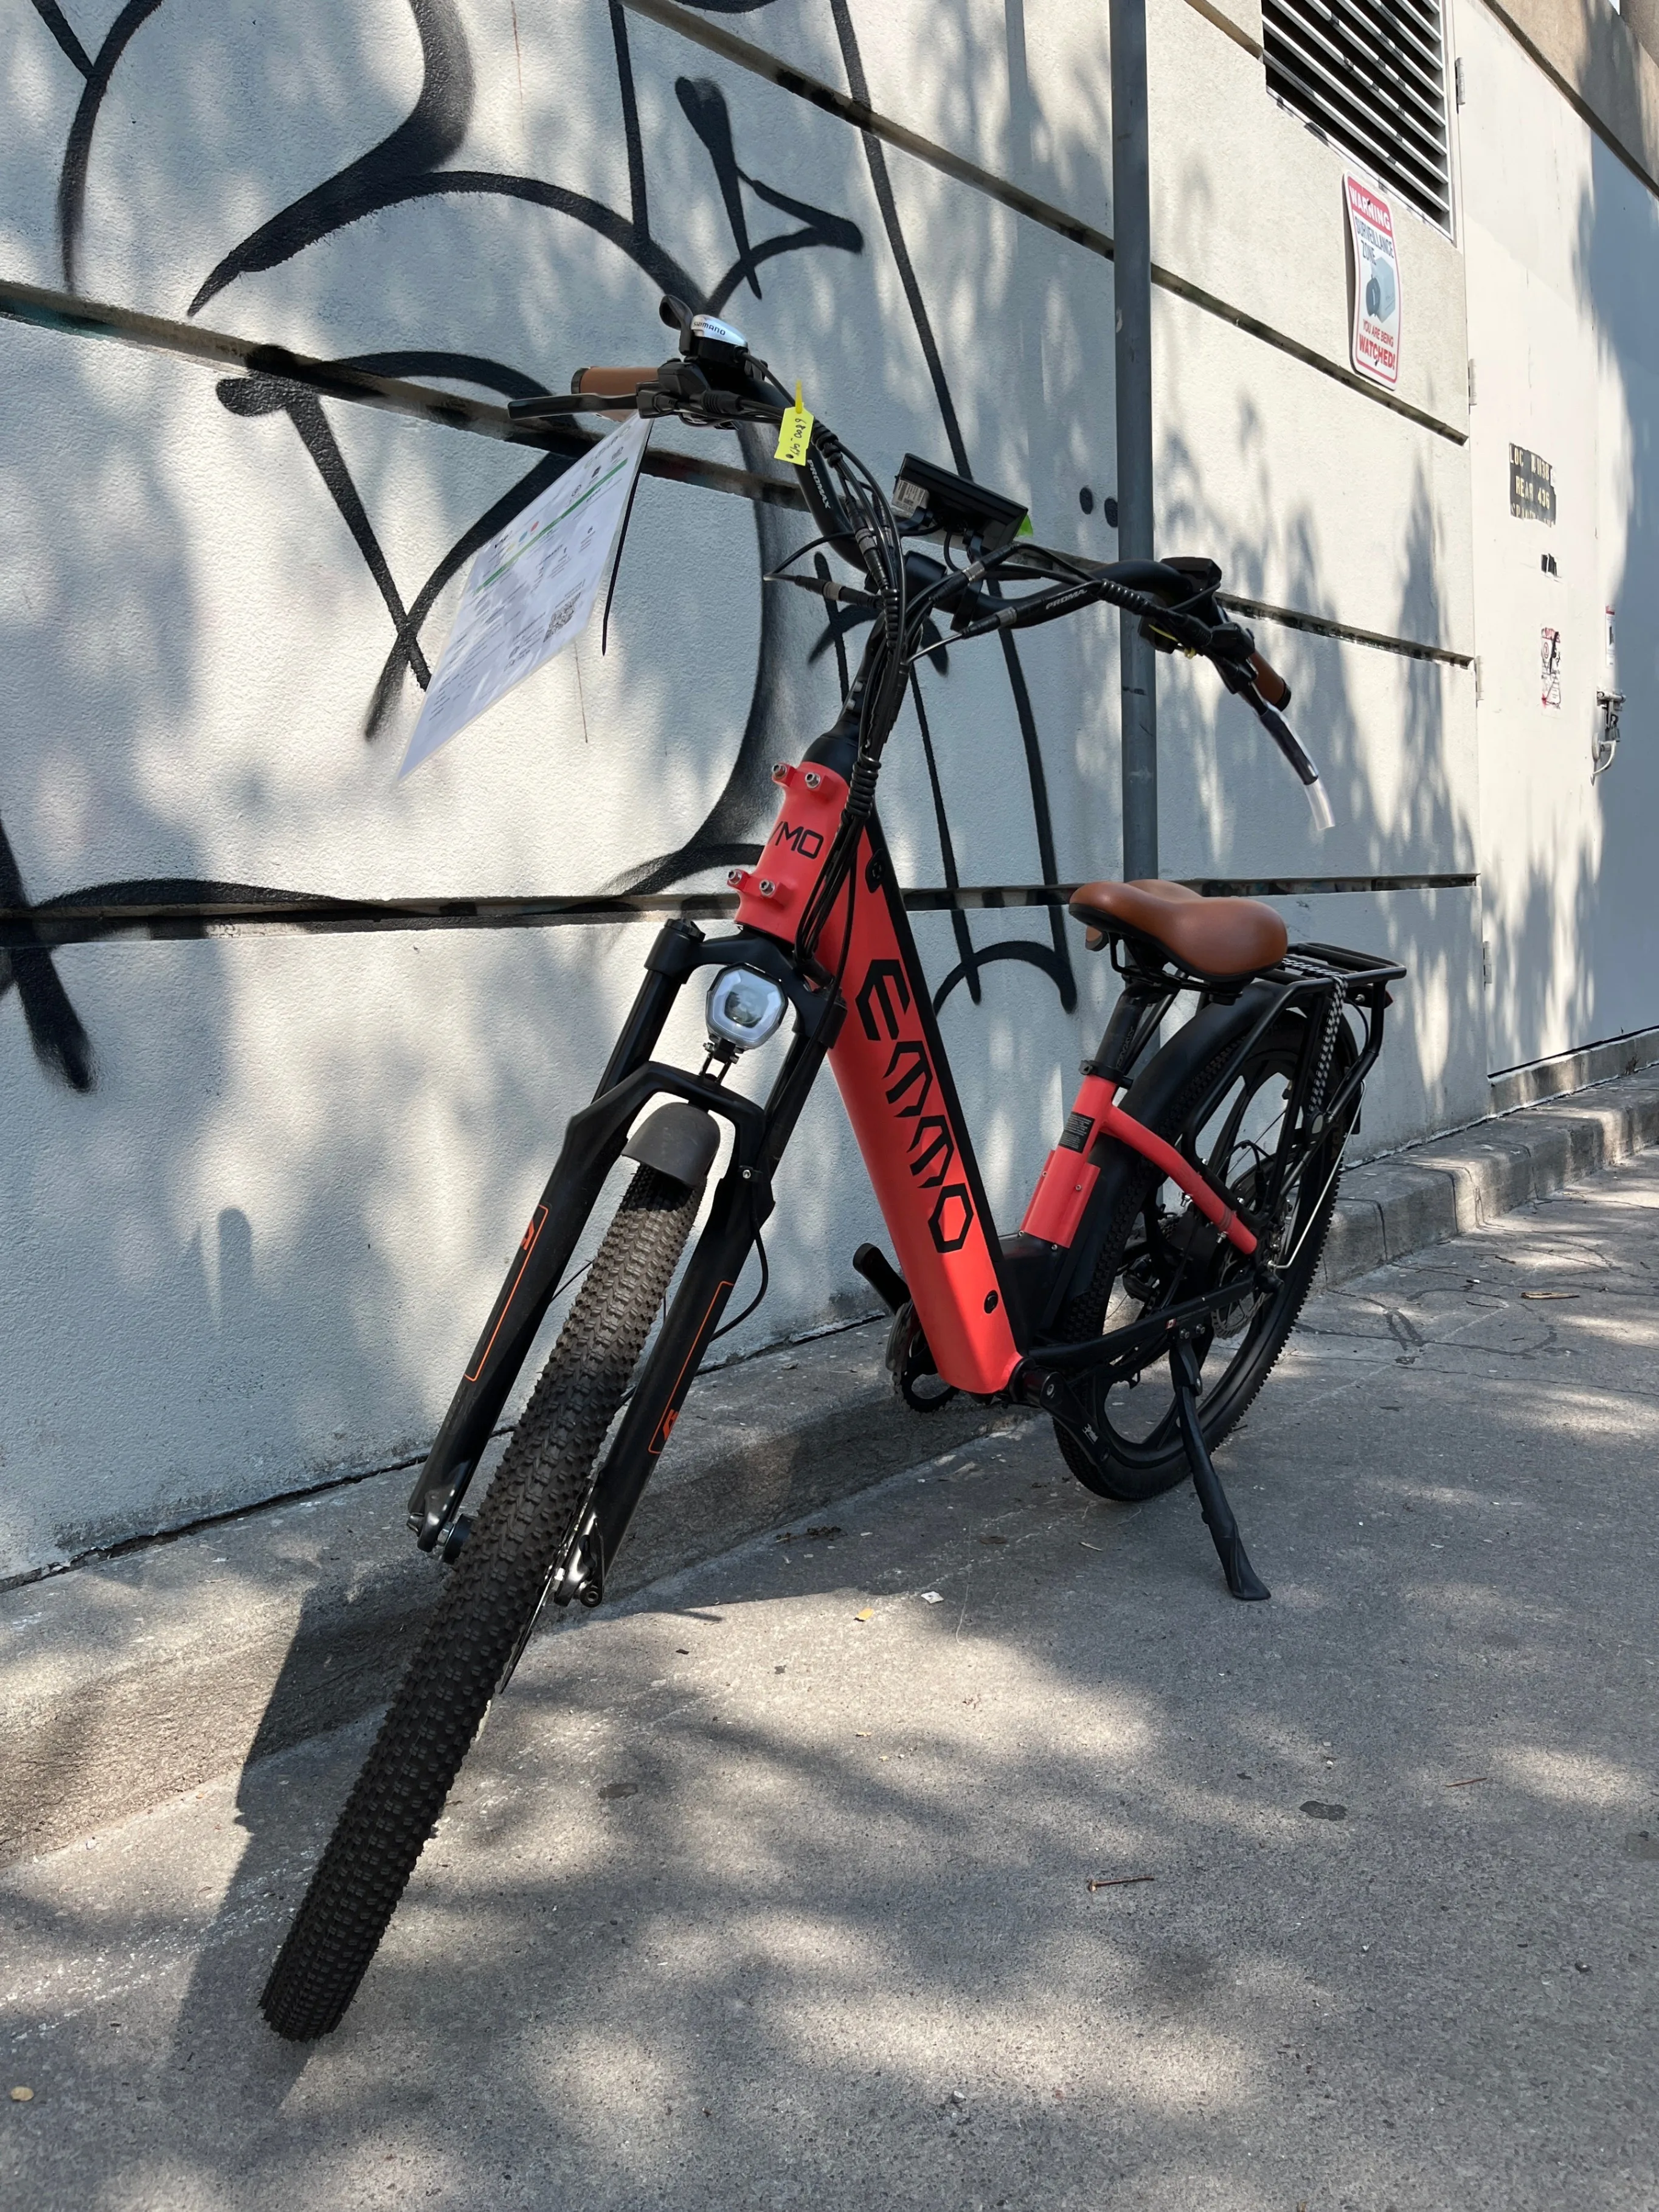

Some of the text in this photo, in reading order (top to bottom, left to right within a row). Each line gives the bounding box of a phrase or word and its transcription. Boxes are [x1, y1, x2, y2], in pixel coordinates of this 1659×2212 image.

[1349, 185, 1391, 231] WARNING
[1355, 216, 1394, 258] SURVEILLANCE
[1361, 240, 1376, 265] ZONE
[694, 321, 726, 336] SHIMANO
[1363, 319, 1394, 347] YOU ARE BEING
[1359, 334, 1396, 370] WATCHED!
[1509, 444, 1523, 467] LOC
[807, 459, 831, 509] PROMAX
[1515, 475, 1550, 510] REAR 436
[768, 820, 824, 859] MO
